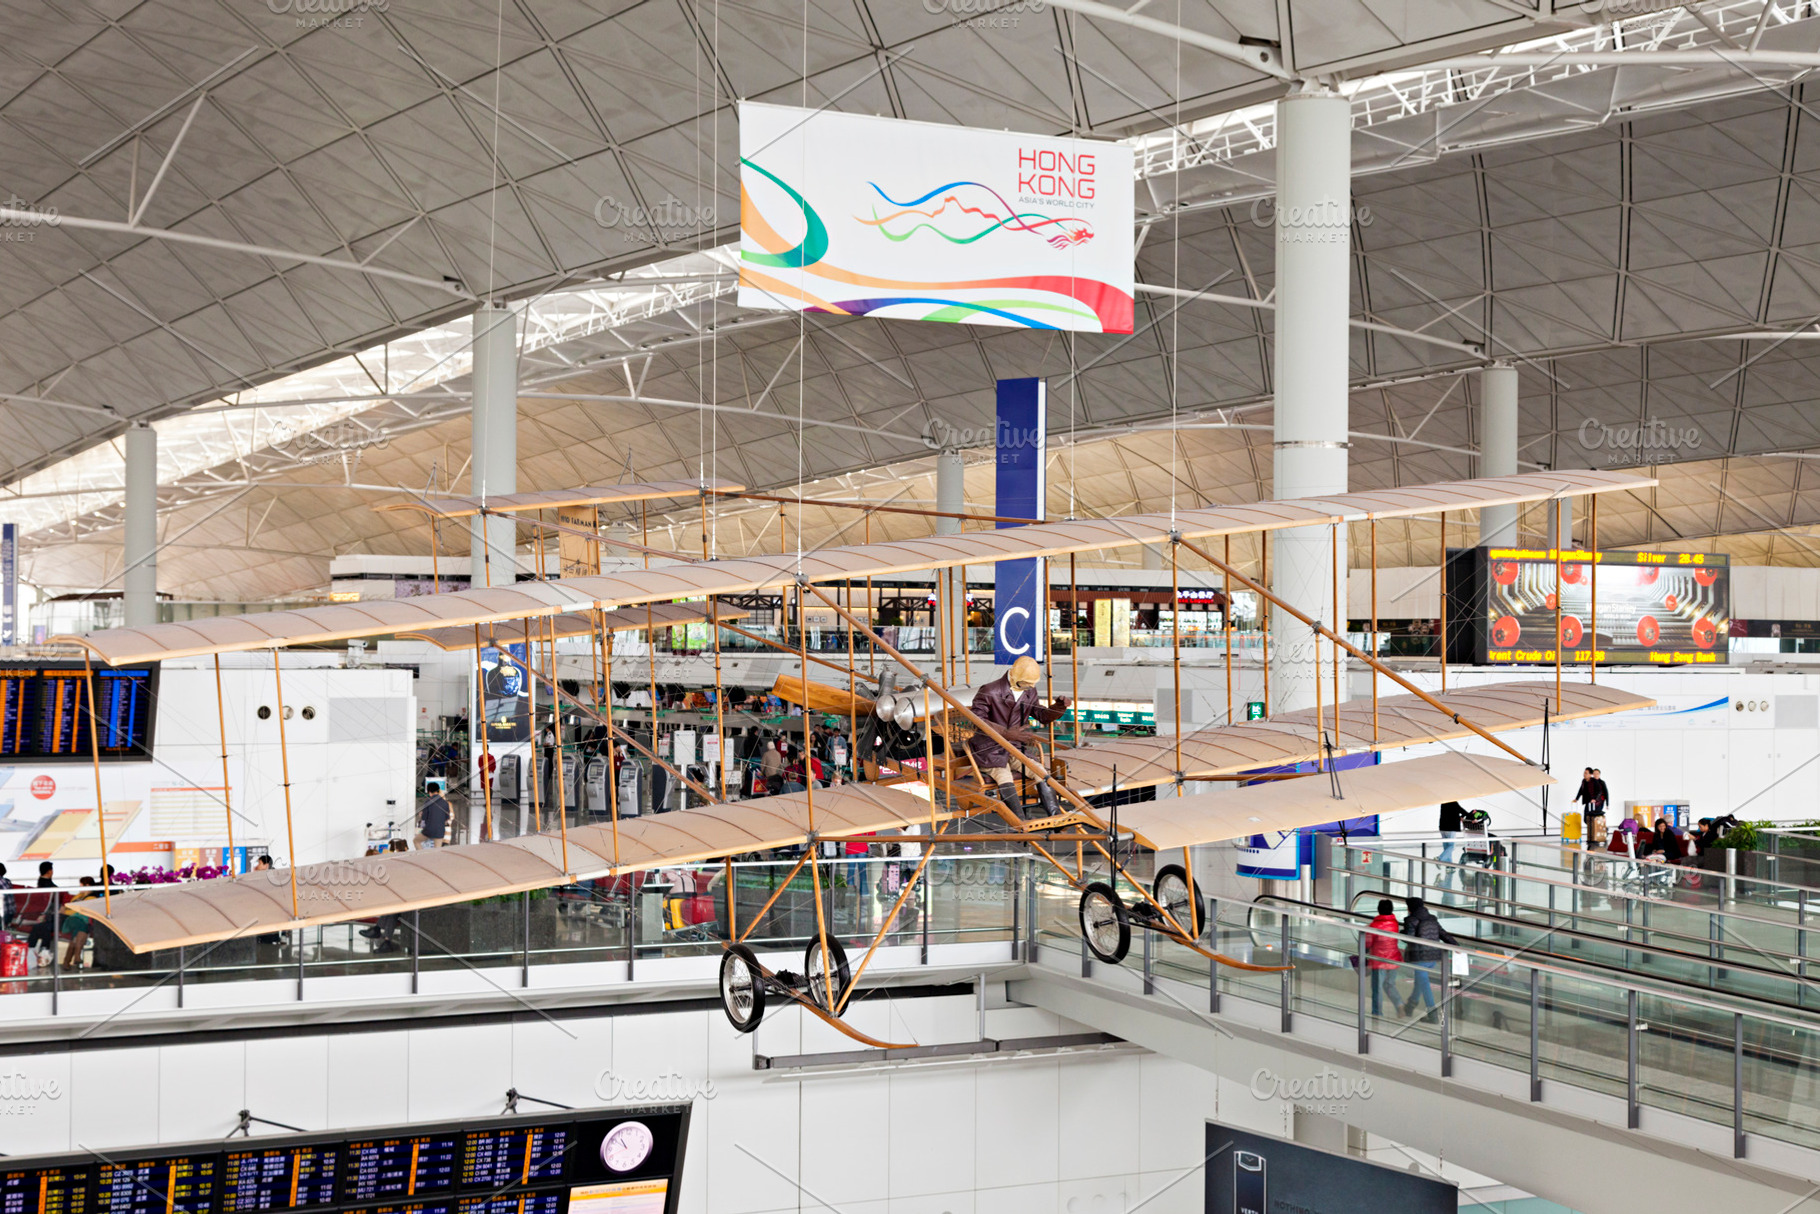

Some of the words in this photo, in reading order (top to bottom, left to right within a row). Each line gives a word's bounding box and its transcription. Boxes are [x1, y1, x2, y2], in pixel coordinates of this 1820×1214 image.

[1018, 148, 1095, 175] HONG
[1018, 172, 1095, 199] KONG
[1019, 196, 1044, 205] ASIA'S
[1046, 199, 1074, 208] WORLD
[1637, 552, 1666, 563] Silver
[1000, 607, 1030, 655] C
[1515, 650, 1542, 661] Crude
[1545, 650, 1555, 661] Oi
[1650, 651, 1671, 664] Hang
[1673, 651, 1694, 664] Seng
[1696, 652, 1716, 662] Bank
